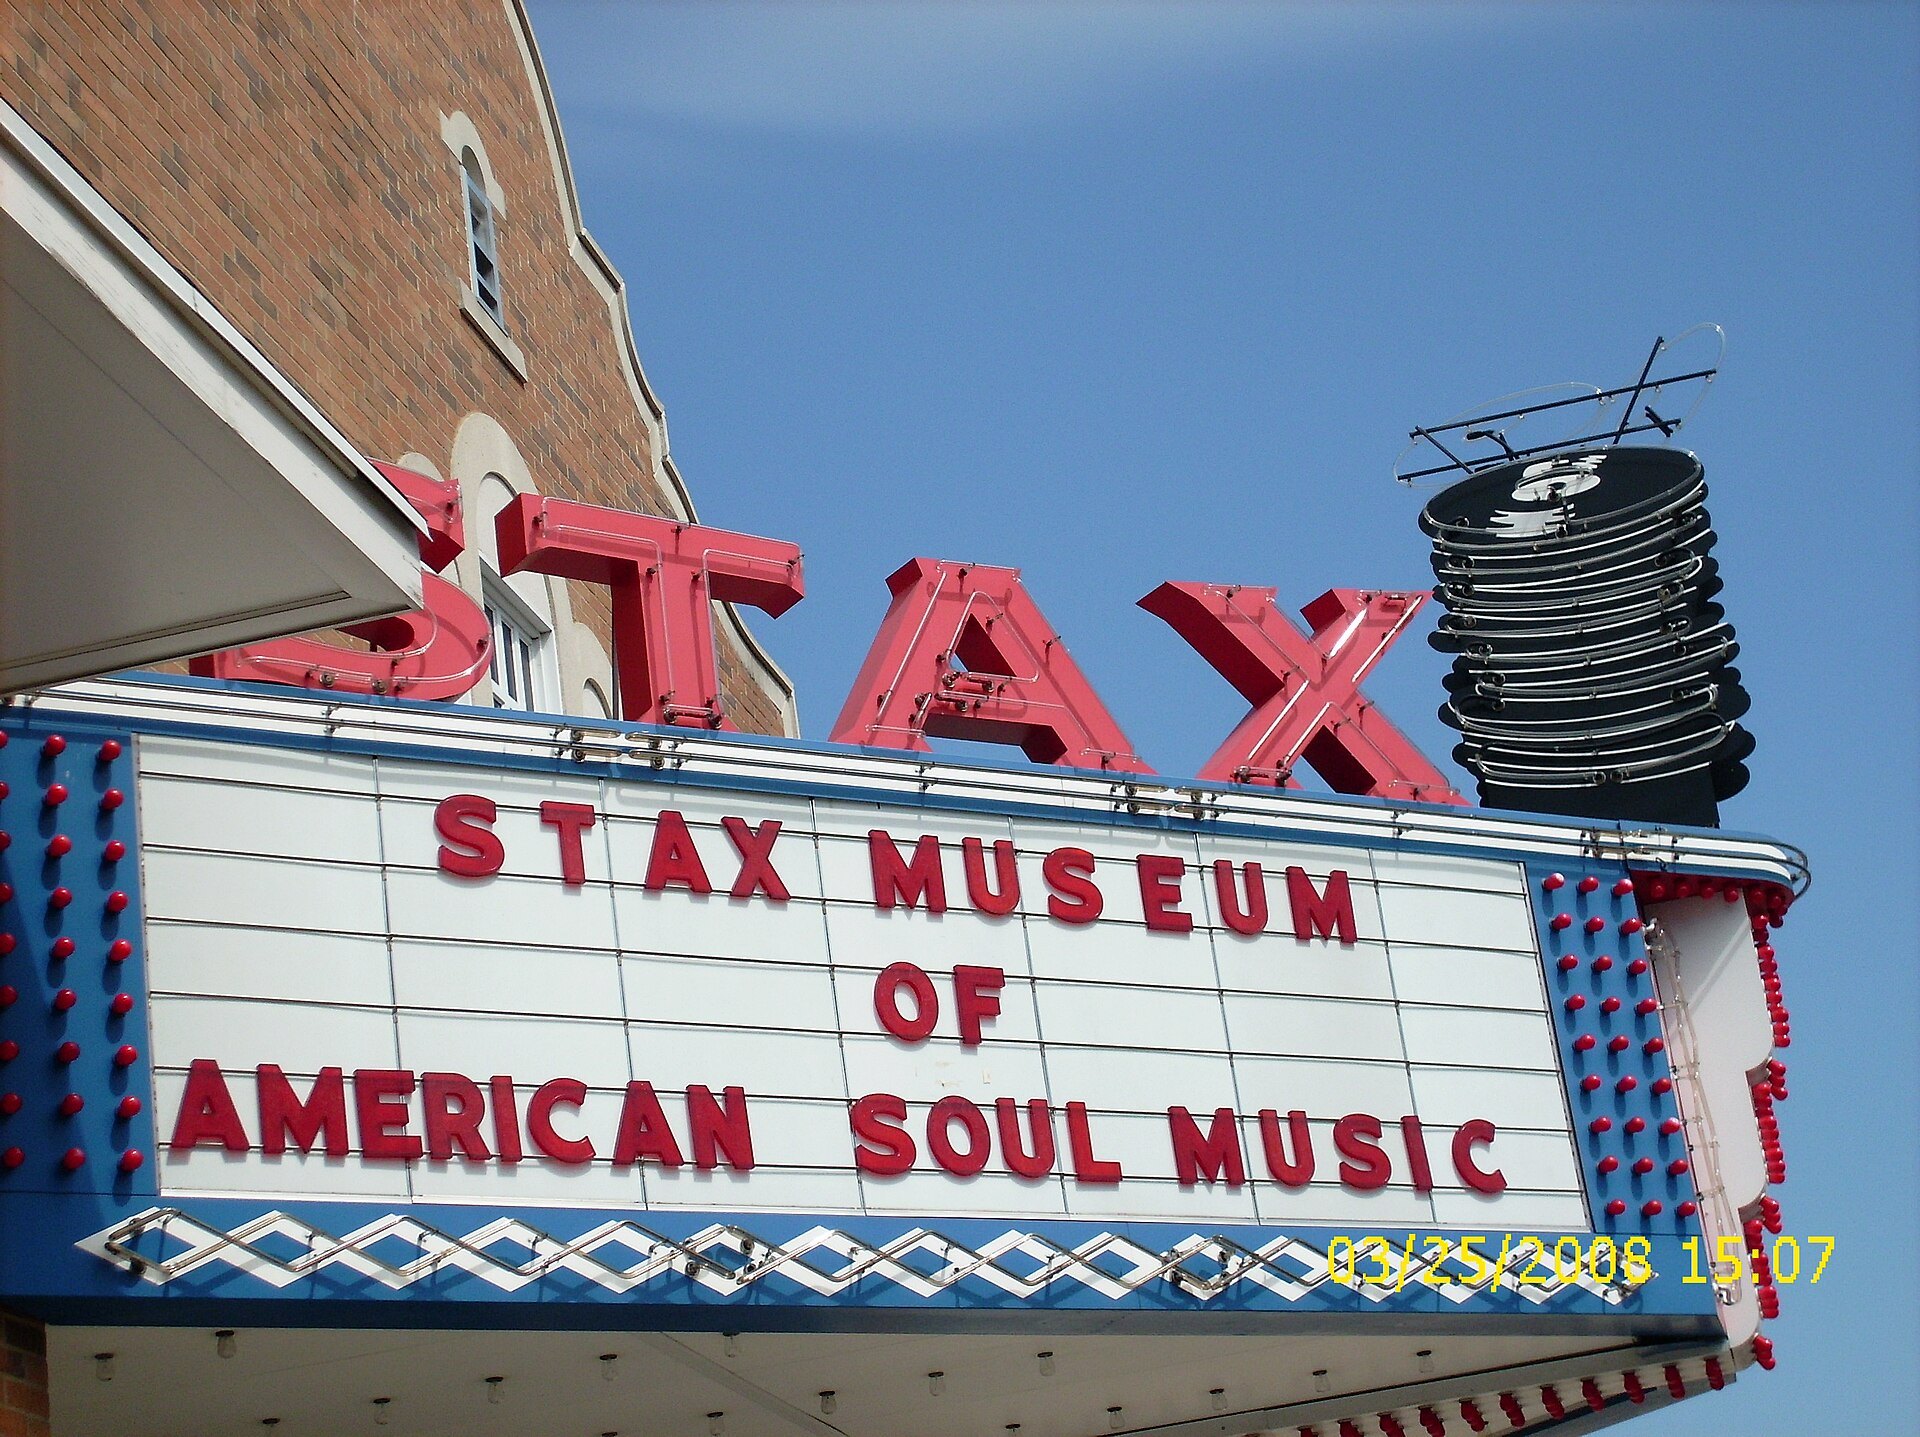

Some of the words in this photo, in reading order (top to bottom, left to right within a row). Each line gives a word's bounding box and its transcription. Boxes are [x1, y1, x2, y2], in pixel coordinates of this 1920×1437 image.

[435, 795, 790, 902] STAX
[869, 830, 1357, 945] MUSEUM
[874, 962, 1005, 1046] OF
[171, 1059, 754, 1175] AMERICAN
[850, 1093, 1122, 1184] SOUL
[1169, 1106, 1506, 1195] MUSIC
